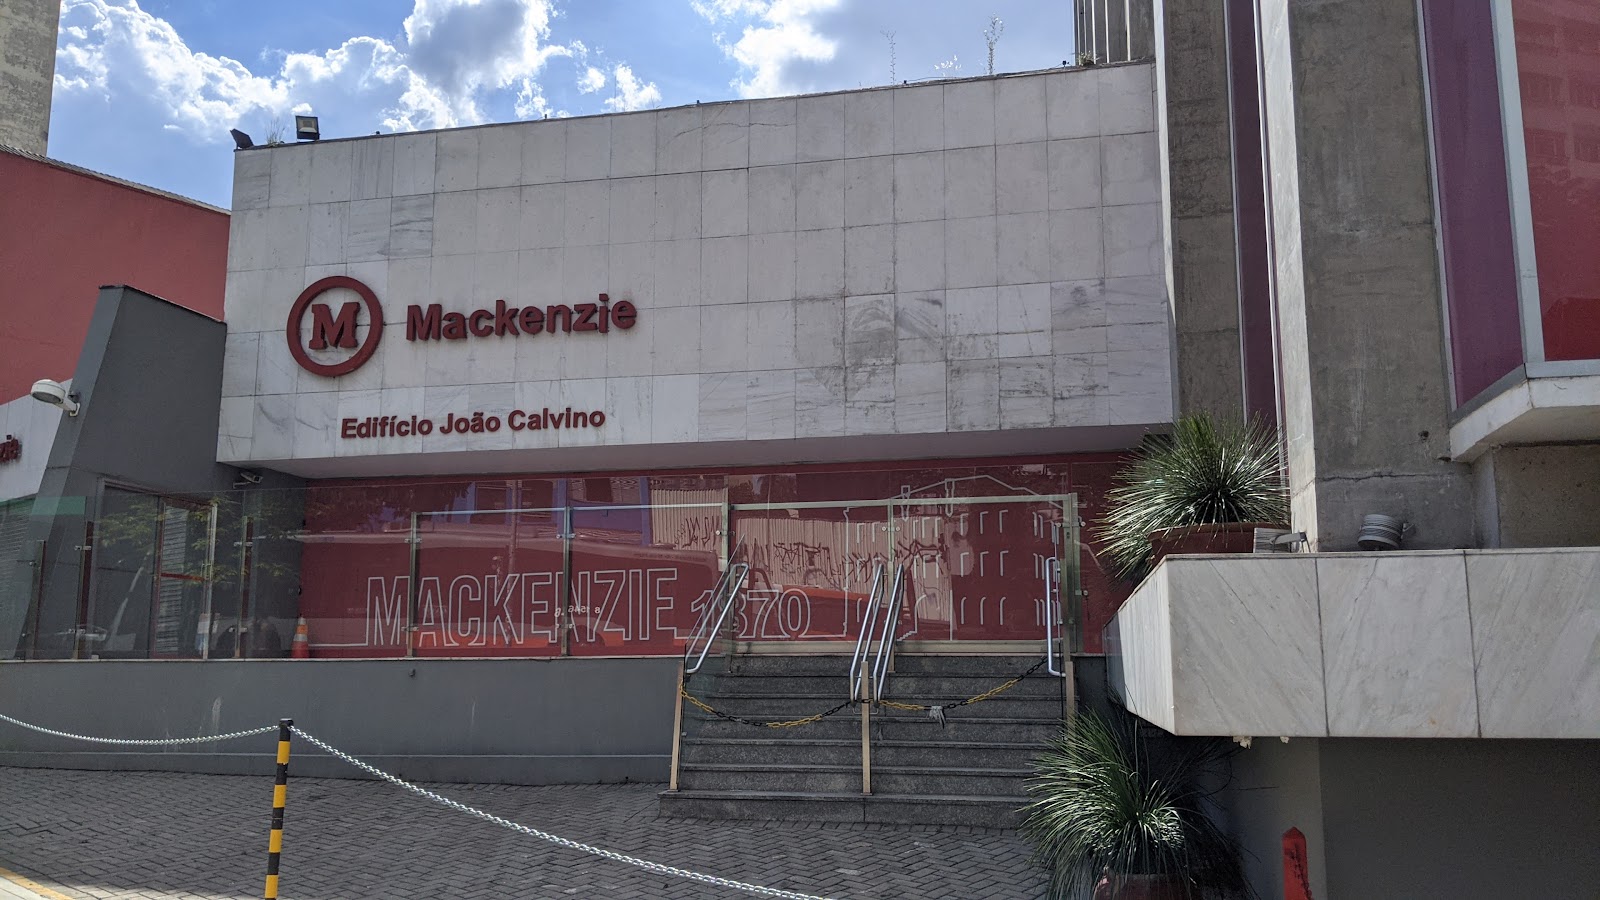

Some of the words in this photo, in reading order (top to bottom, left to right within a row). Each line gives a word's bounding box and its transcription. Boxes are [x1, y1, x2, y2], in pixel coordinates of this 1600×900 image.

[309, 301, 361, 350] M
[406, 293, 638, 342] Mackenzie
[340, 416, 433, 439] Edifício
[440, 412, 502, 435] João
[508, 407, 606, 431] Calvino
[366, 568, 679, 648] MACKENZIE
[691, 588, 811, 639] 1870
